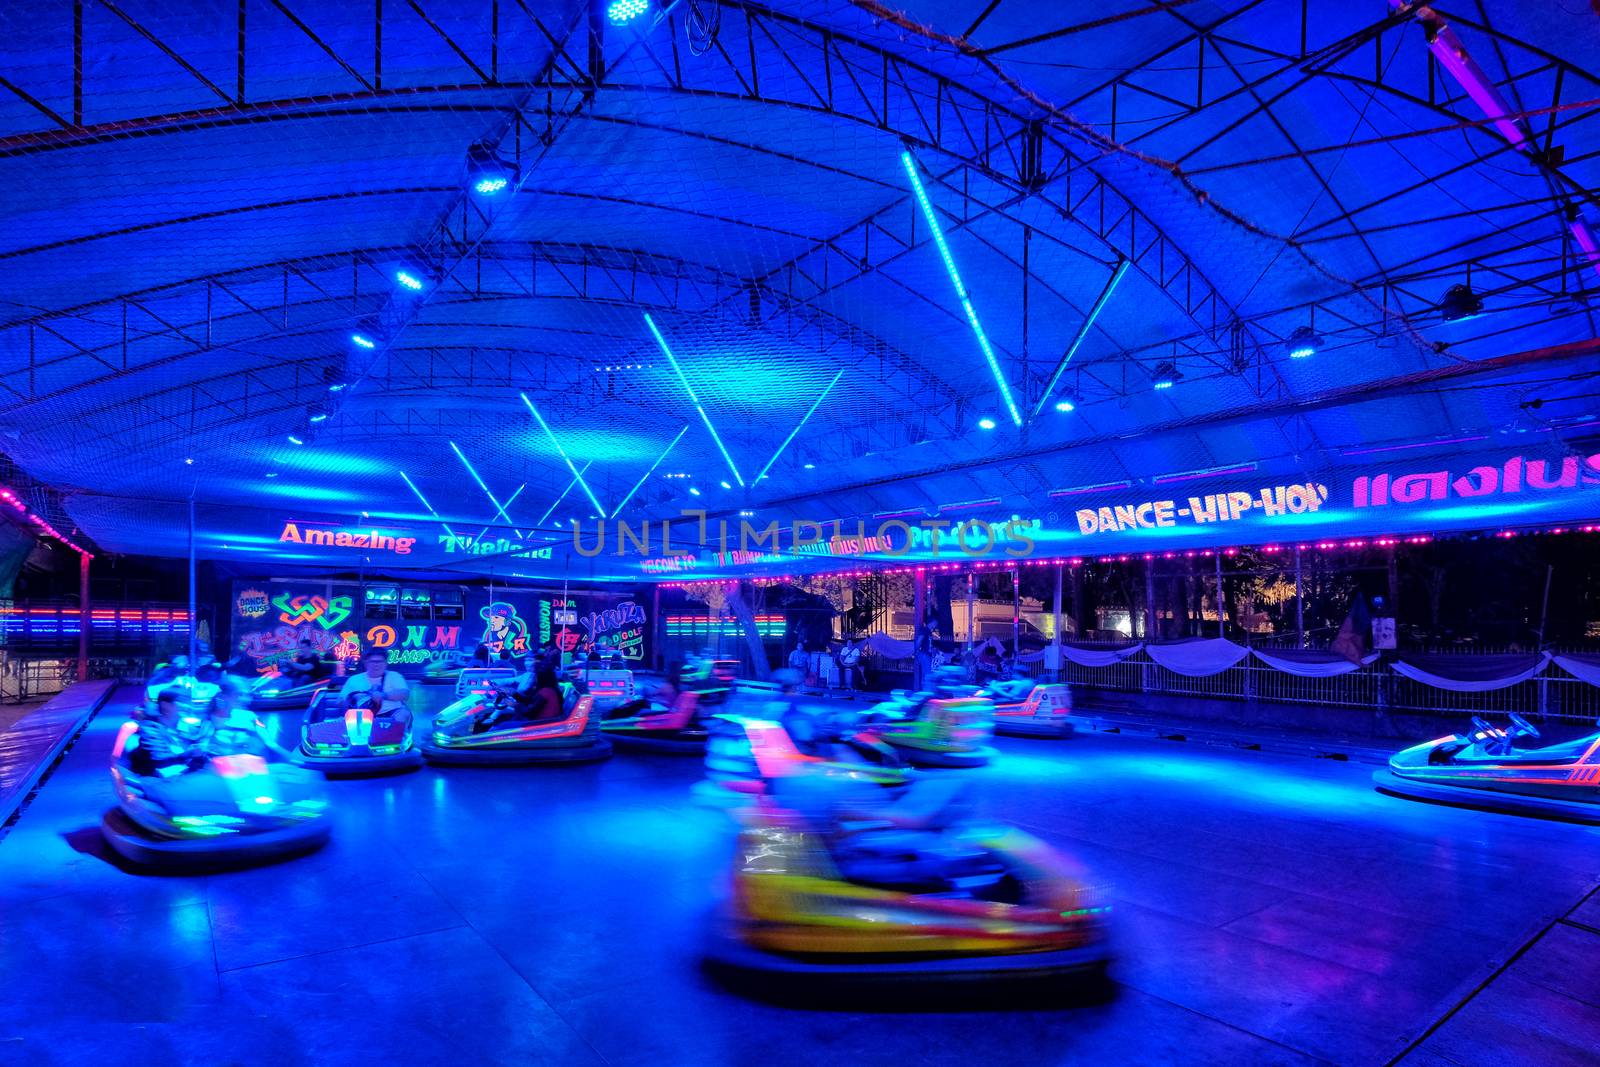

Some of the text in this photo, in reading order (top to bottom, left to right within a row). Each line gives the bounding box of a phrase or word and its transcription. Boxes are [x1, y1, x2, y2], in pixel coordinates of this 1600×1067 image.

[279, 523, 553, 560] Amazing Thailand
[639, 556, 682, 574] WELCOME
[683, 554, 696, 571] TO
[240, 597, 266, 606] DANCE
[240, 605, 268, 613] HOUSE
